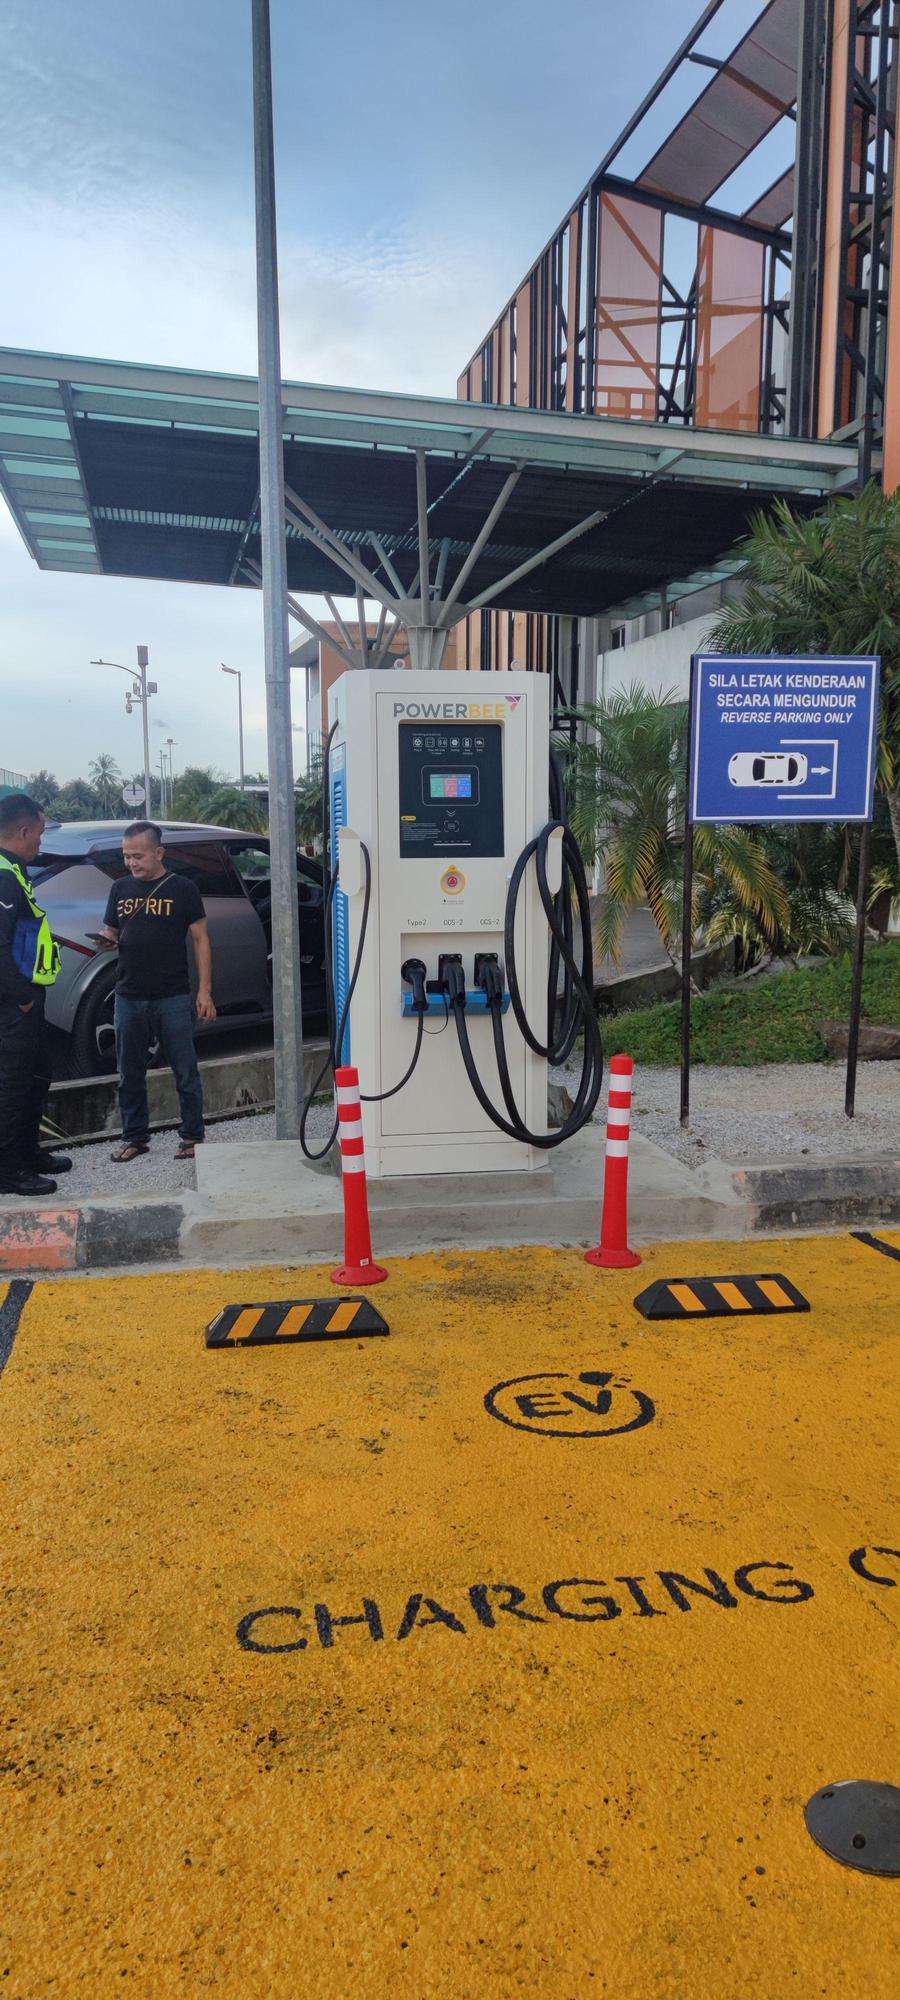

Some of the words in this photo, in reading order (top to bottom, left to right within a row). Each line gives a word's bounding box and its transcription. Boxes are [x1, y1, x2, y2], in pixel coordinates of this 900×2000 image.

[709, 674, 738, 687] SILA
[741, 674, 782, 688] LETAK
[786, 675, 866, 689] KENDERAAN
[717, 694, 770, 707] SECARA
[774, 694, 856, 708] MENGUNDUR
[393, 702, 506, 719] POWERBEE
[720, 712, 771, 723] REVERSE
[774, 712, 821, 723] PARKING
[824, 712, 853, 723] ONLY
[479, 918, 500, 926] CCS-2
[514, 1389, 613, 1418] EV
[236, 1561, 815, 1653] CHARGING
